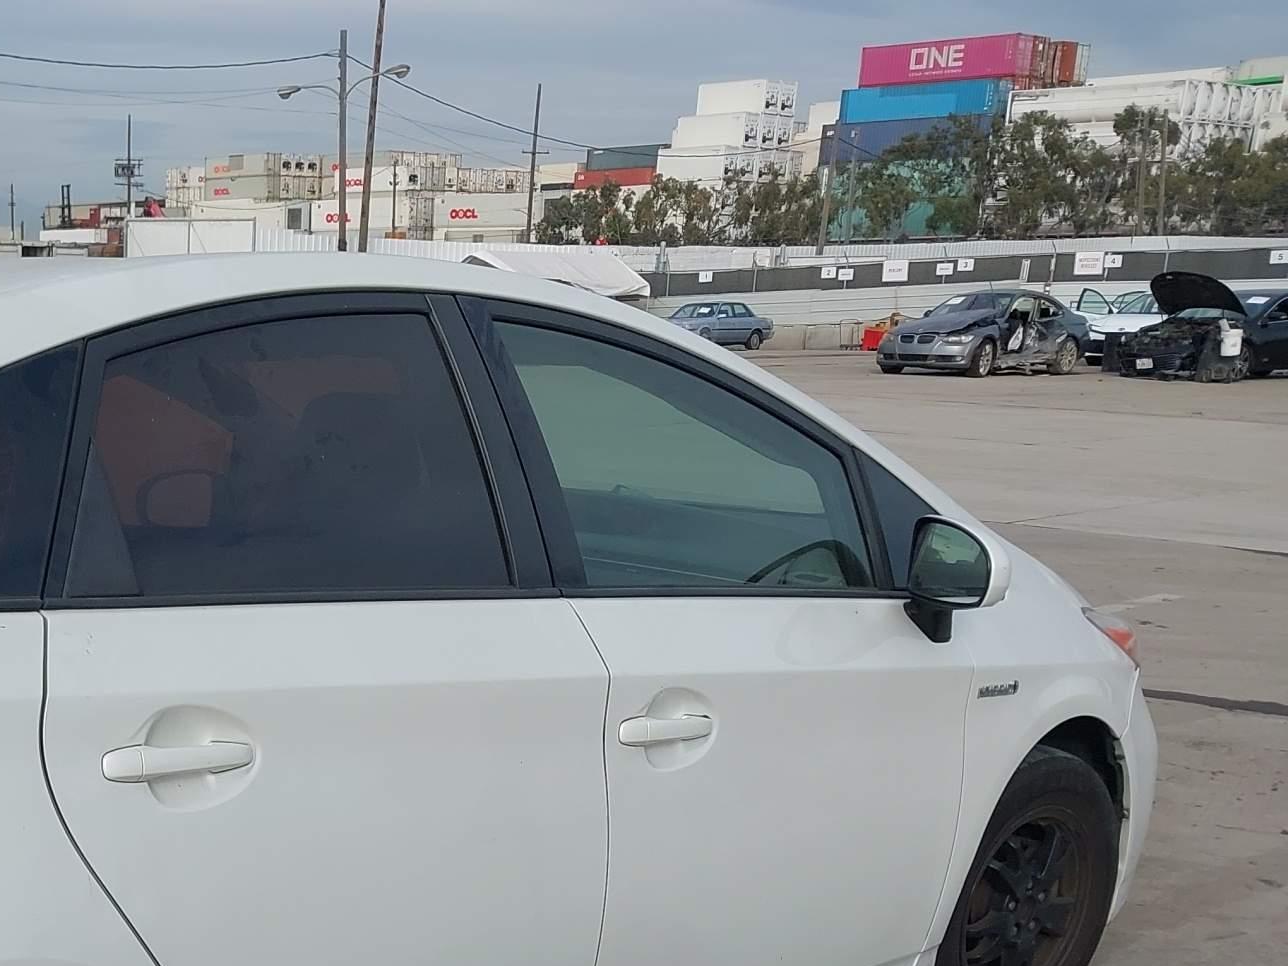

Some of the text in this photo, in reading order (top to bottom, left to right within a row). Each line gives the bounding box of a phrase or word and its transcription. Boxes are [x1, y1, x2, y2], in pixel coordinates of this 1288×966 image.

[909, 44, 965, 70] ONE
[325, 213, 352, 223] OOL
[449, 209, 478, 219] OOCL
